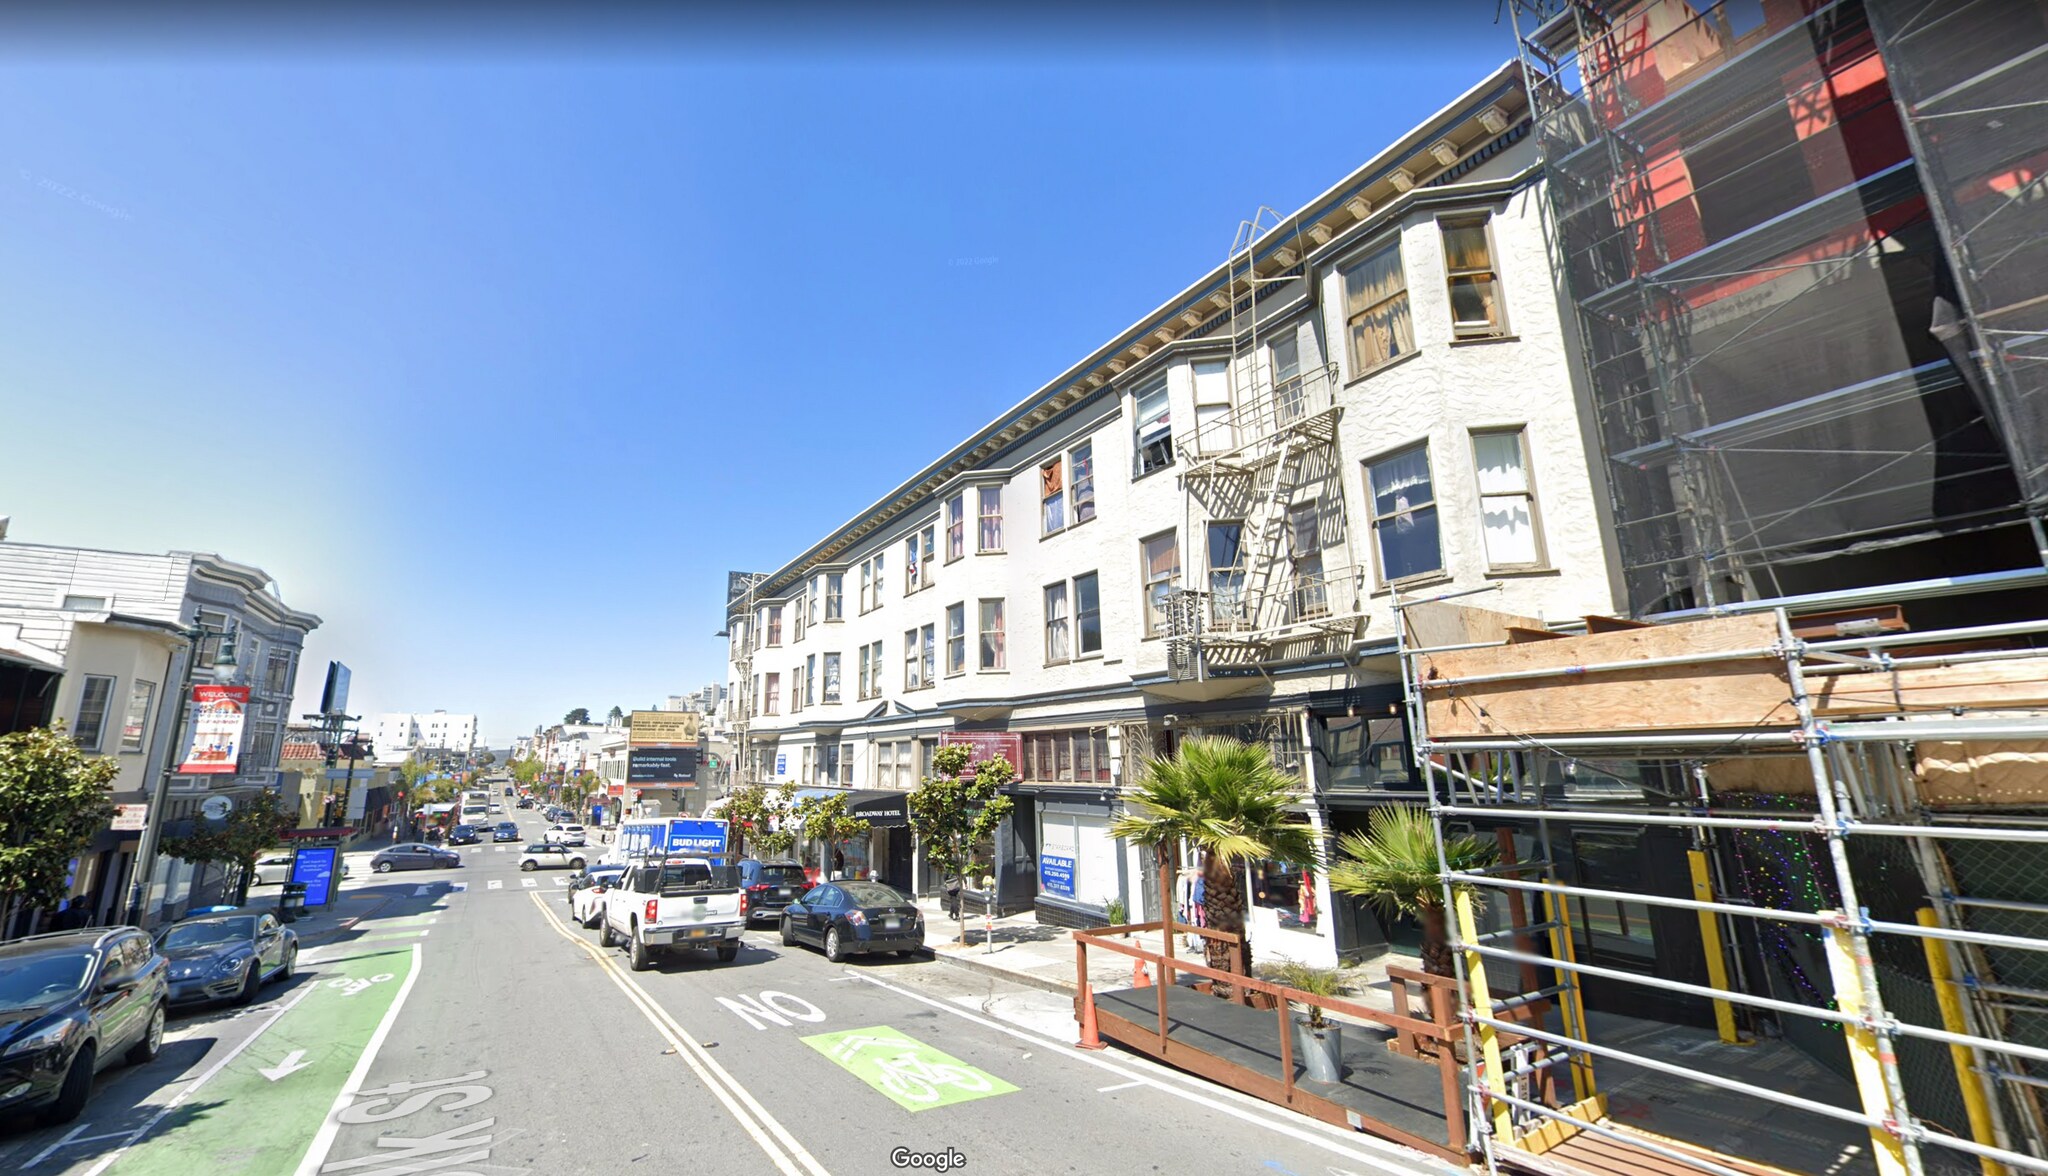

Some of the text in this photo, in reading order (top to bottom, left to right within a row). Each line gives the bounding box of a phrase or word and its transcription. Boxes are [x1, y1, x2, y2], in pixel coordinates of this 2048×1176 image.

[199, 691, 243, 699] WELCOME
[855, 810, 883, 818] BROADWAY
[672, 838, 721, 848] BUD LIGHT
[1042, 857, 1073, 869] AVAILABLE
[713, 990, 827, 1031] NO
